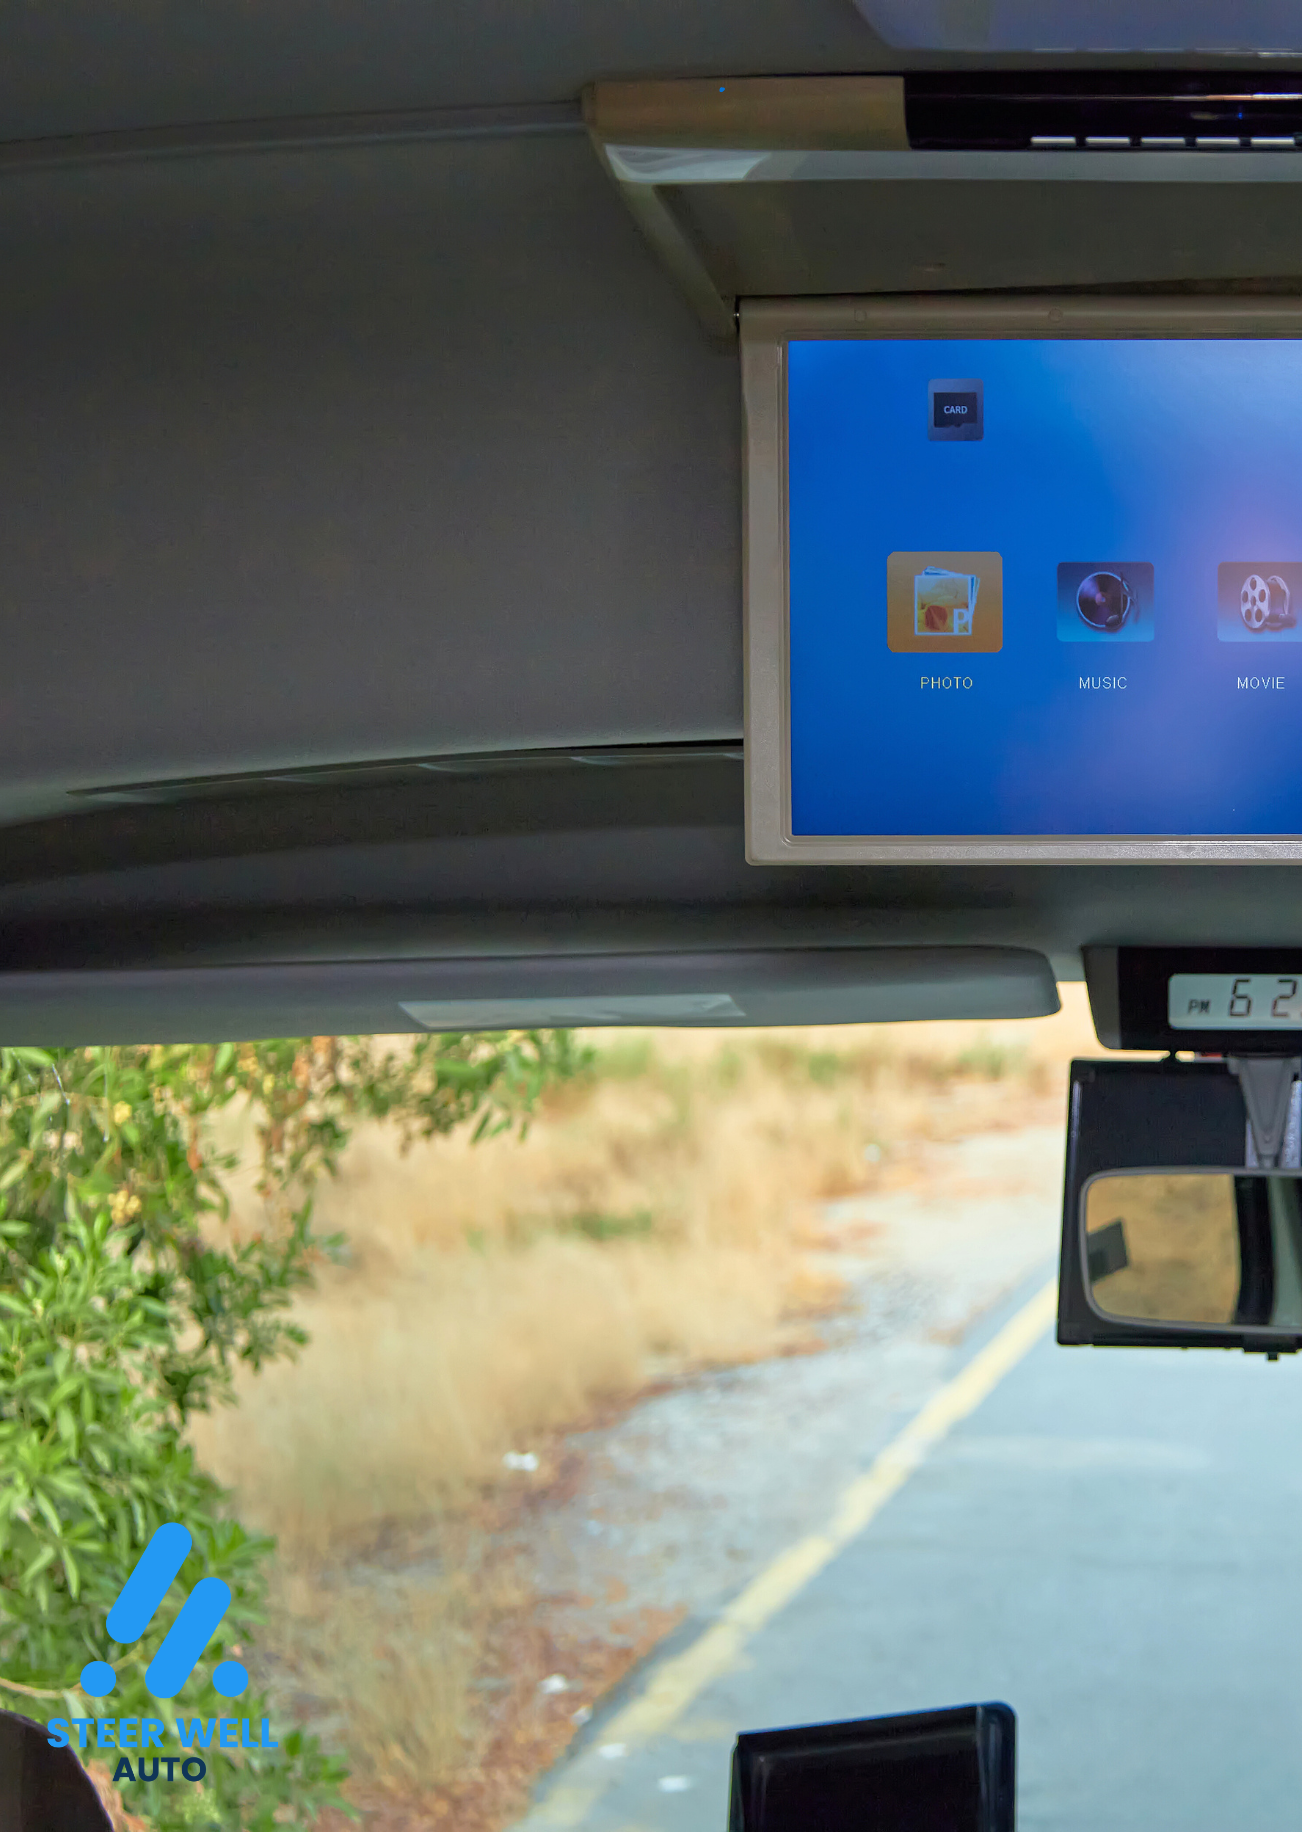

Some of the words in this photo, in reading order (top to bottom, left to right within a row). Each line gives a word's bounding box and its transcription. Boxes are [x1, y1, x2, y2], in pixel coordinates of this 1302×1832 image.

[943, 405, 968, 415] CARD
[920, 676, 973, 690] PHOTO
[1079, 676, 1128, 690] MUSIC
[1237, 676, 1285, 690] MOVIE
[1187, 998, 1211, 1014] PM
